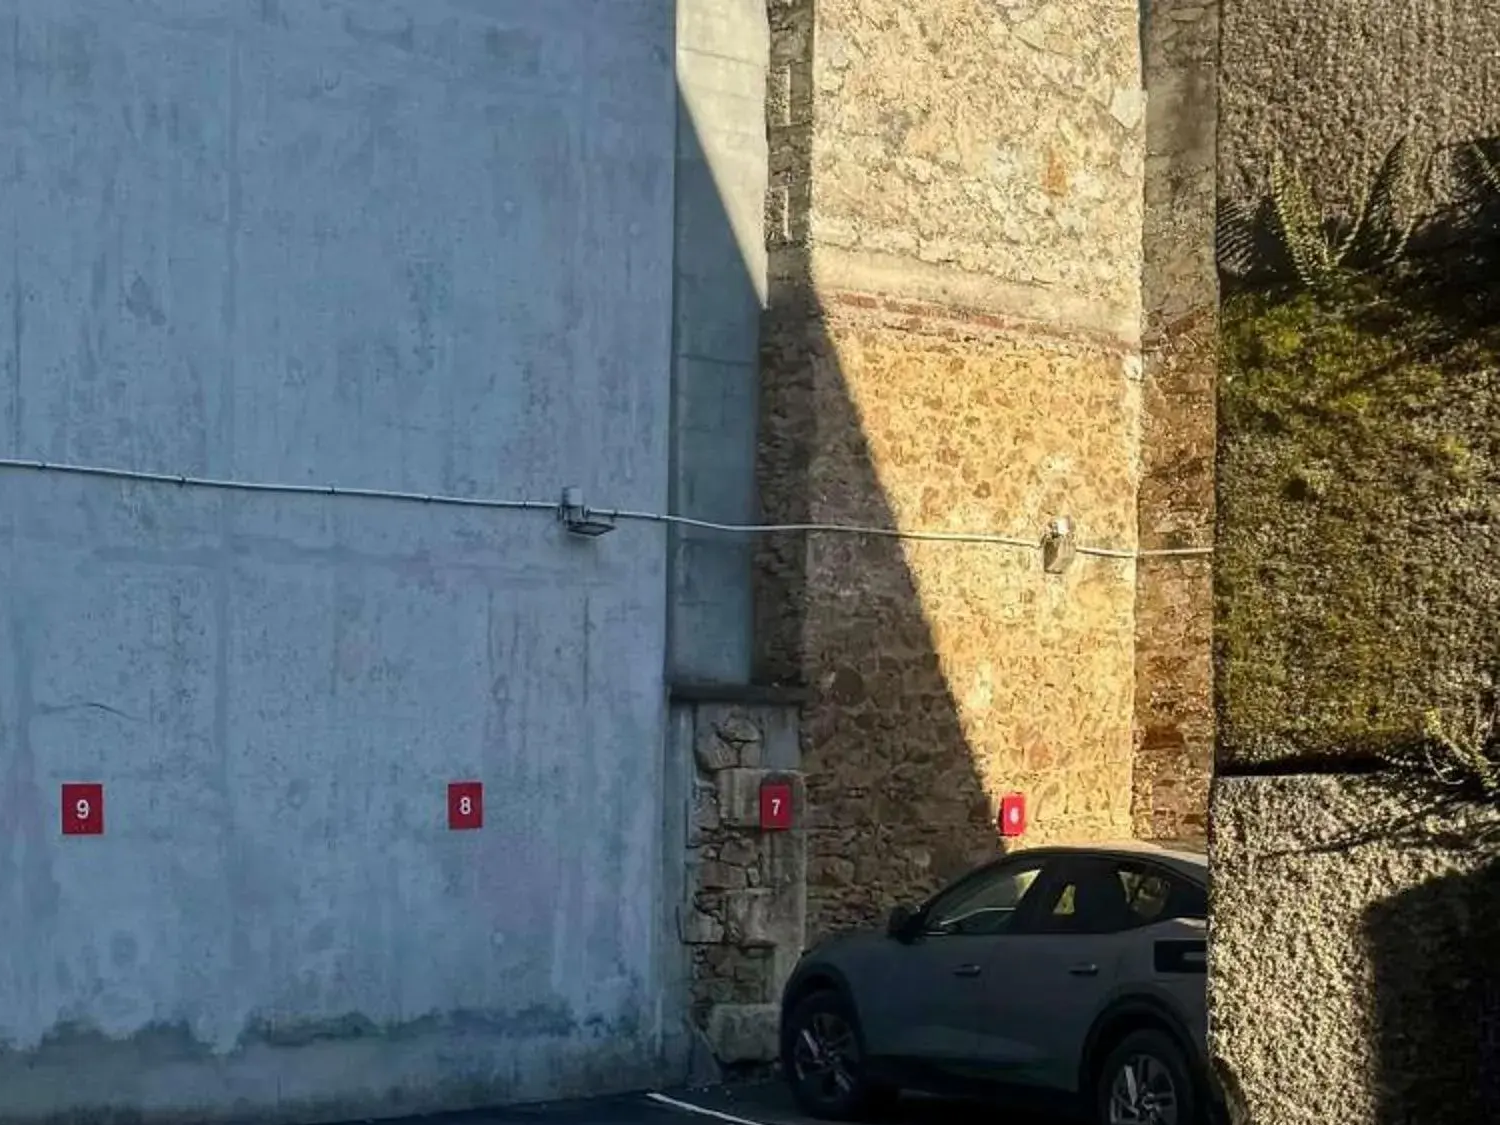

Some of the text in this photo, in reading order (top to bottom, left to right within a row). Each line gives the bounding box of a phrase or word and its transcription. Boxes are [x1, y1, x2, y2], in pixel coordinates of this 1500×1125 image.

[76, 799, 89, 819] 9
[460, 796, 471, 815] 8
[771, 798, 781, 817] 7
